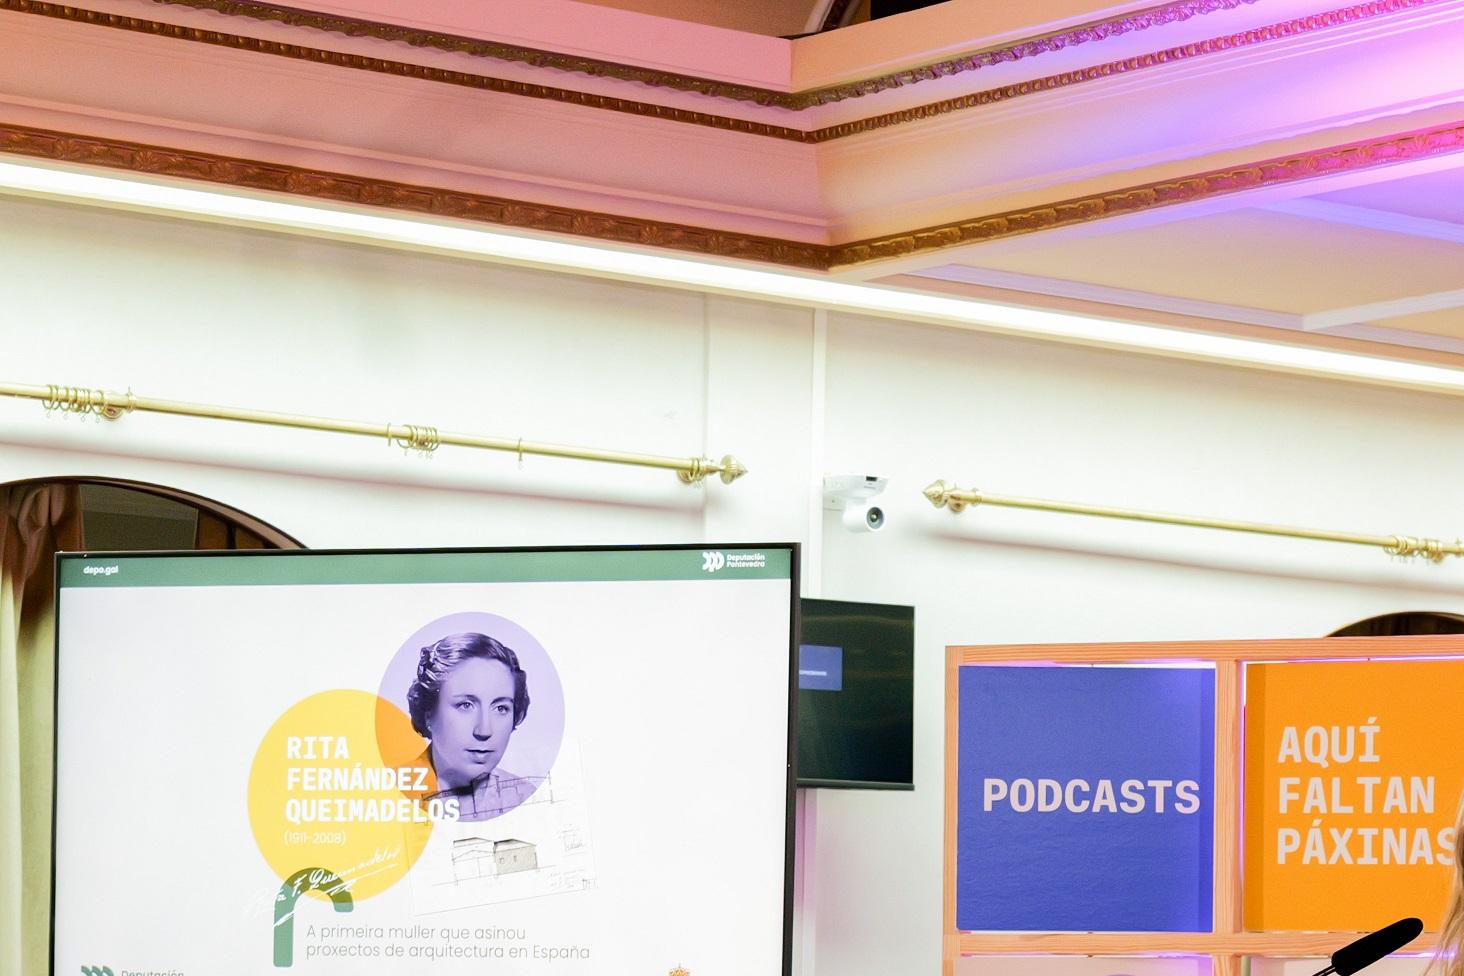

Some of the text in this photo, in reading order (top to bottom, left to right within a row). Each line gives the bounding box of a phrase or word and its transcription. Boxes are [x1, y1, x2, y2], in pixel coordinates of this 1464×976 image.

[83, 565, 119, 576] depo.gal
[287, 735, 349, 760] RITA
[1278, 716, 1382, 768] AQUÍ
[287, 762, 429, 791] FERNÁNDEZ
[983, 777, 1201, 814] PODCASTS
[1279, 776, 1435, 815] FALTAN
[285, 798, 461, 824] QUEIMADELOS
[1277, 819, 1457, 866] PÁXINAS
[306, 924, 526, 942] A primeira muller que asinou
[306, 943, 590, 962] proxectos de arquitectura en España
